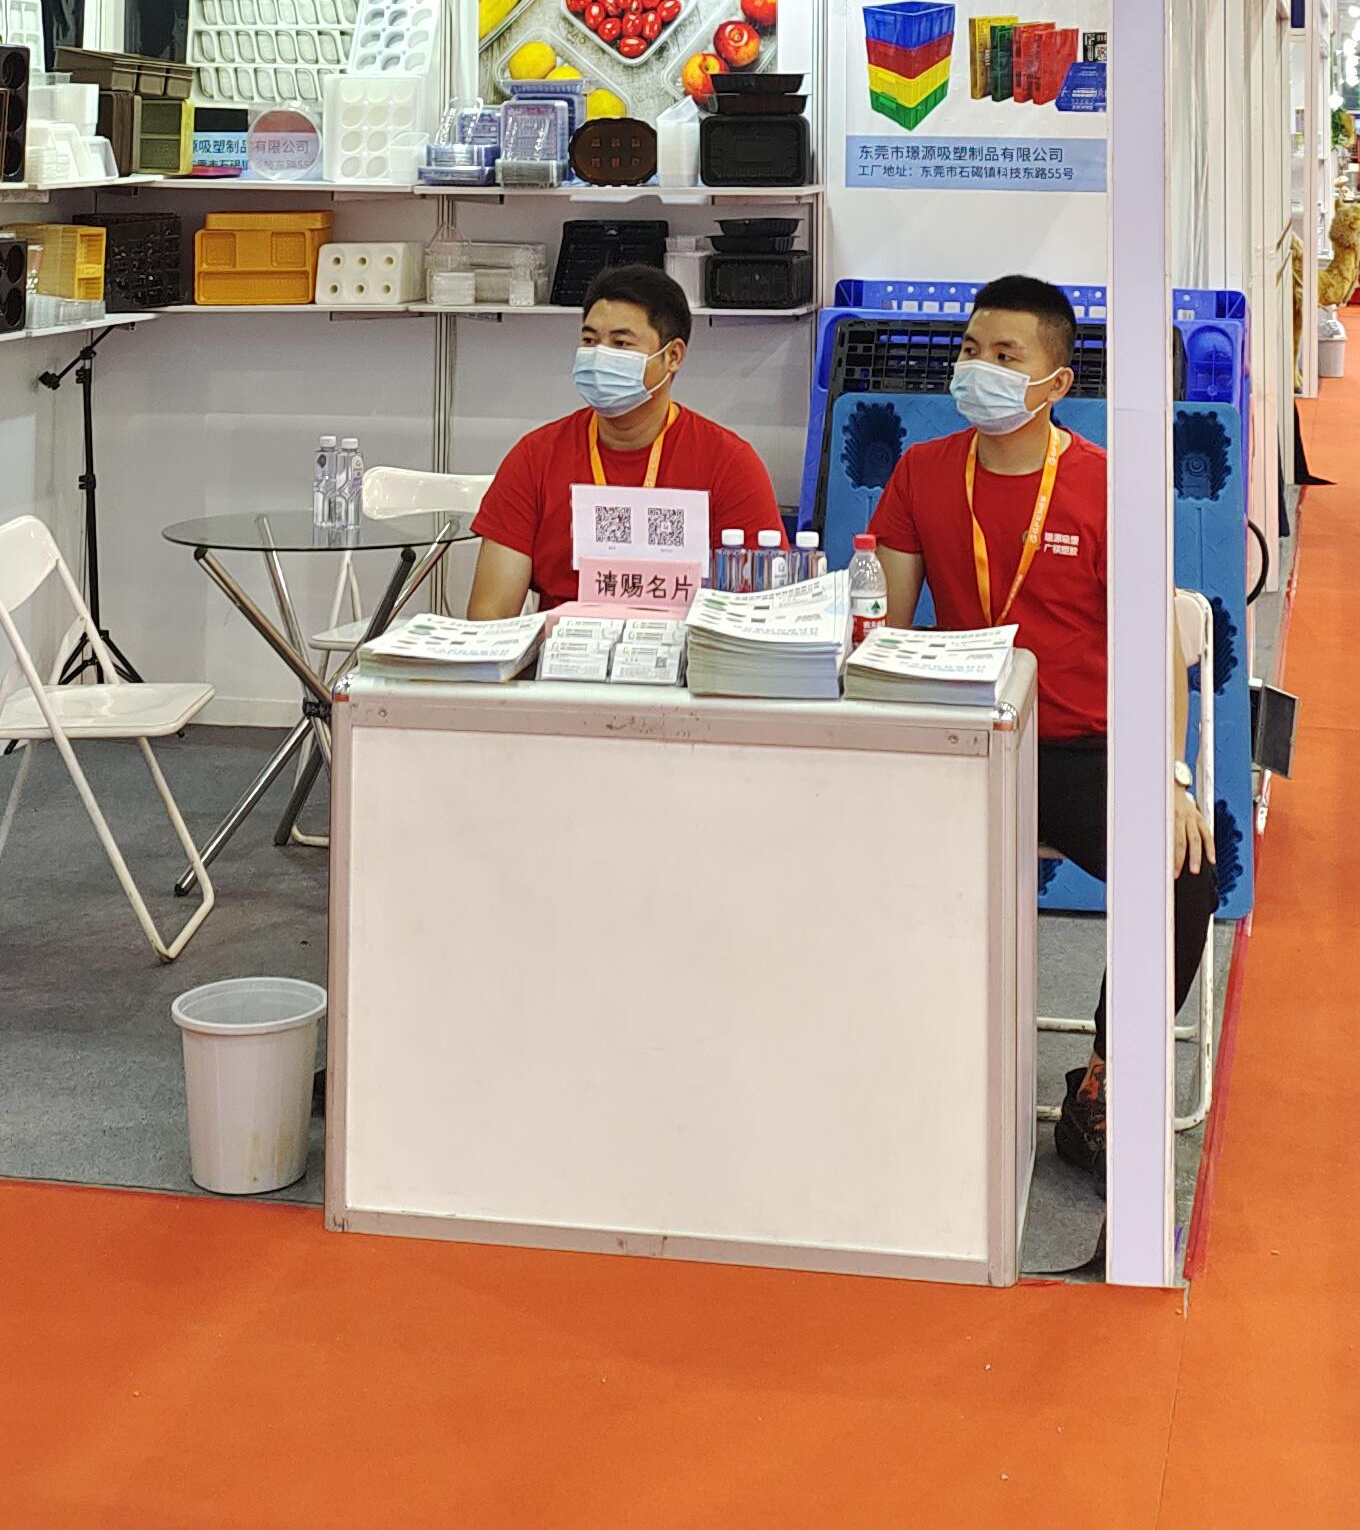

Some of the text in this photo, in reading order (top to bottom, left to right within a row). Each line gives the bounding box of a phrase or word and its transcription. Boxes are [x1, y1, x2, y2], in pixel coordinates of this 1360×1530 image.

[858, 145, 1063, 163] 东莞市璟源吸塑制品有限公司
[595, 570, 693, 602] 请赐名片
